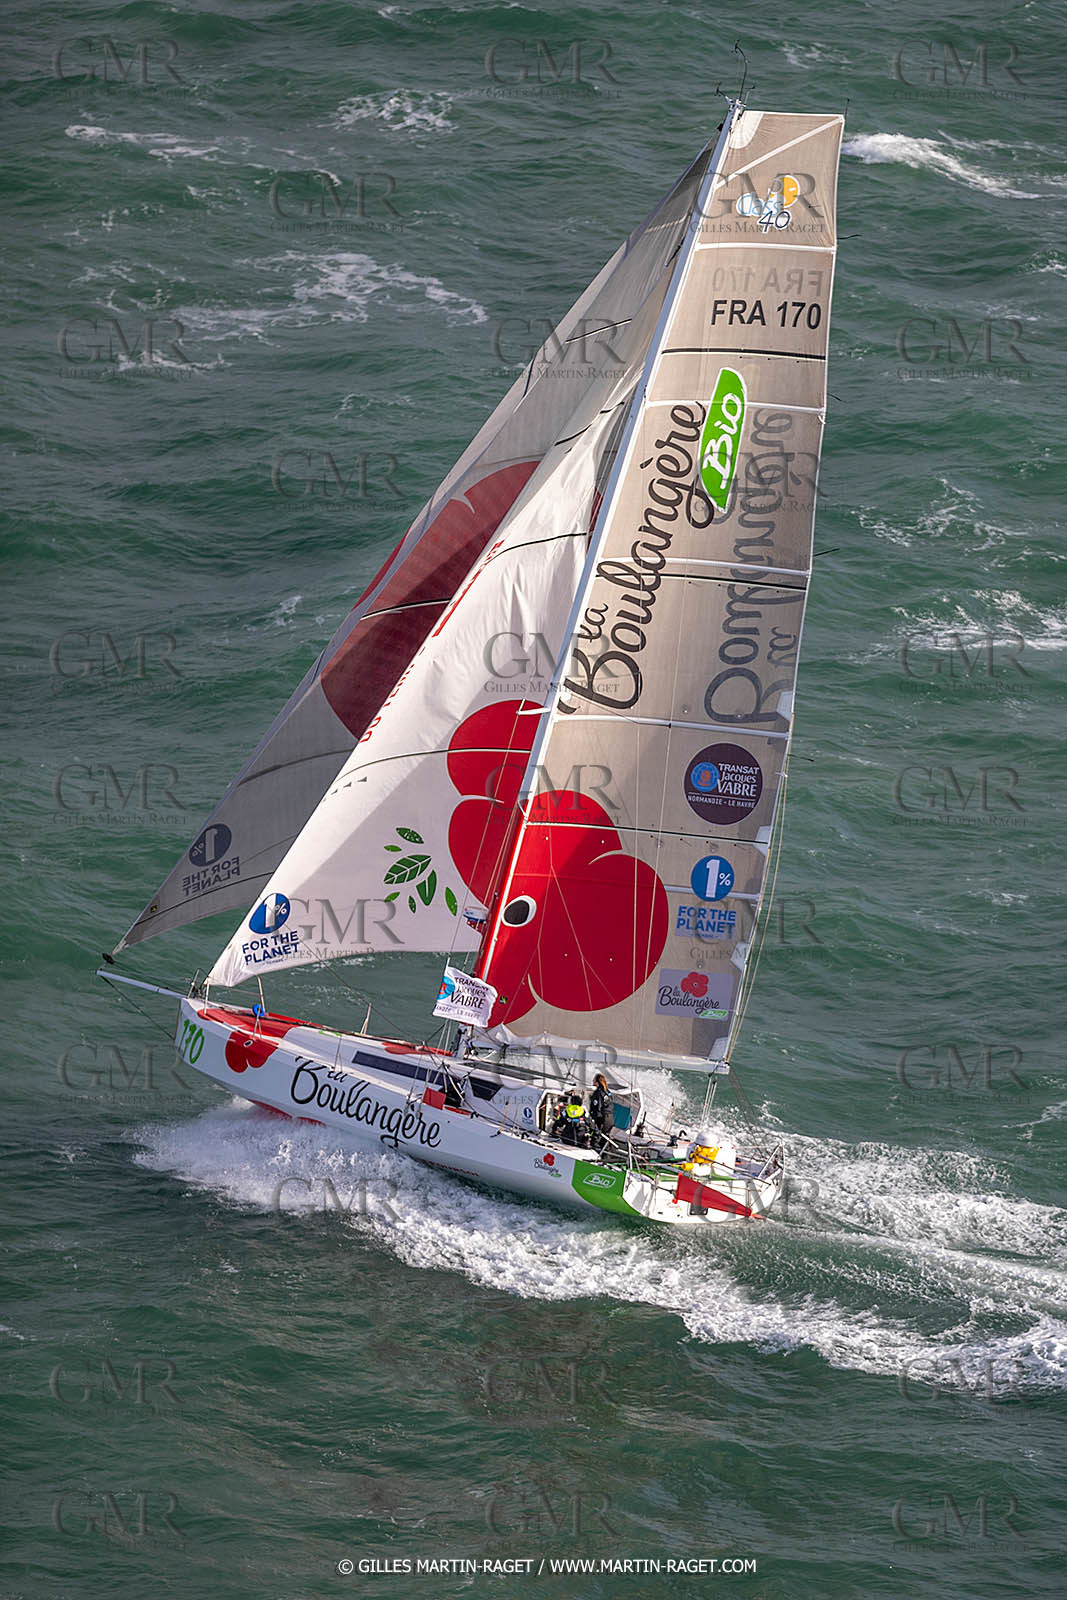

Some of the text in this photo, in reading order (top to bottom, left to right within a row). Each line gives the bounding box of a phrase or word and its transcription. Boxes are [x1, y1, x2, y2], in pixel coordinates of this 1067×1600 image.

[759, 210, 791, 233] 40
[711, 299, 822, 330] FRA 170
[703, 392, 743, 490] Bio
[557, 401, 715, 716] Boulangère
[577, 602, 609, 644] la
[718, 763, 760, 775] TRANSAT
[720, 771, 757, 784] Jacques
[717, 779, 757, 797] VABRE
[706, 859, 731, 898] 1%
[264, 893, 287, 928] 1%
[678, 905, 737, 921] FOR THE
[676, 918, 736, 933] PLANET
[242, 931, 299, 954] FOR THE
[244, 942, 299, 965] PLANET
[451, 991, 486, 1009] VABRE
[659, 986, 720, 1014] Boulangère
[180, 1018, 205, 1064] 170
[291, 1056, 441, 1148] Boulangère
